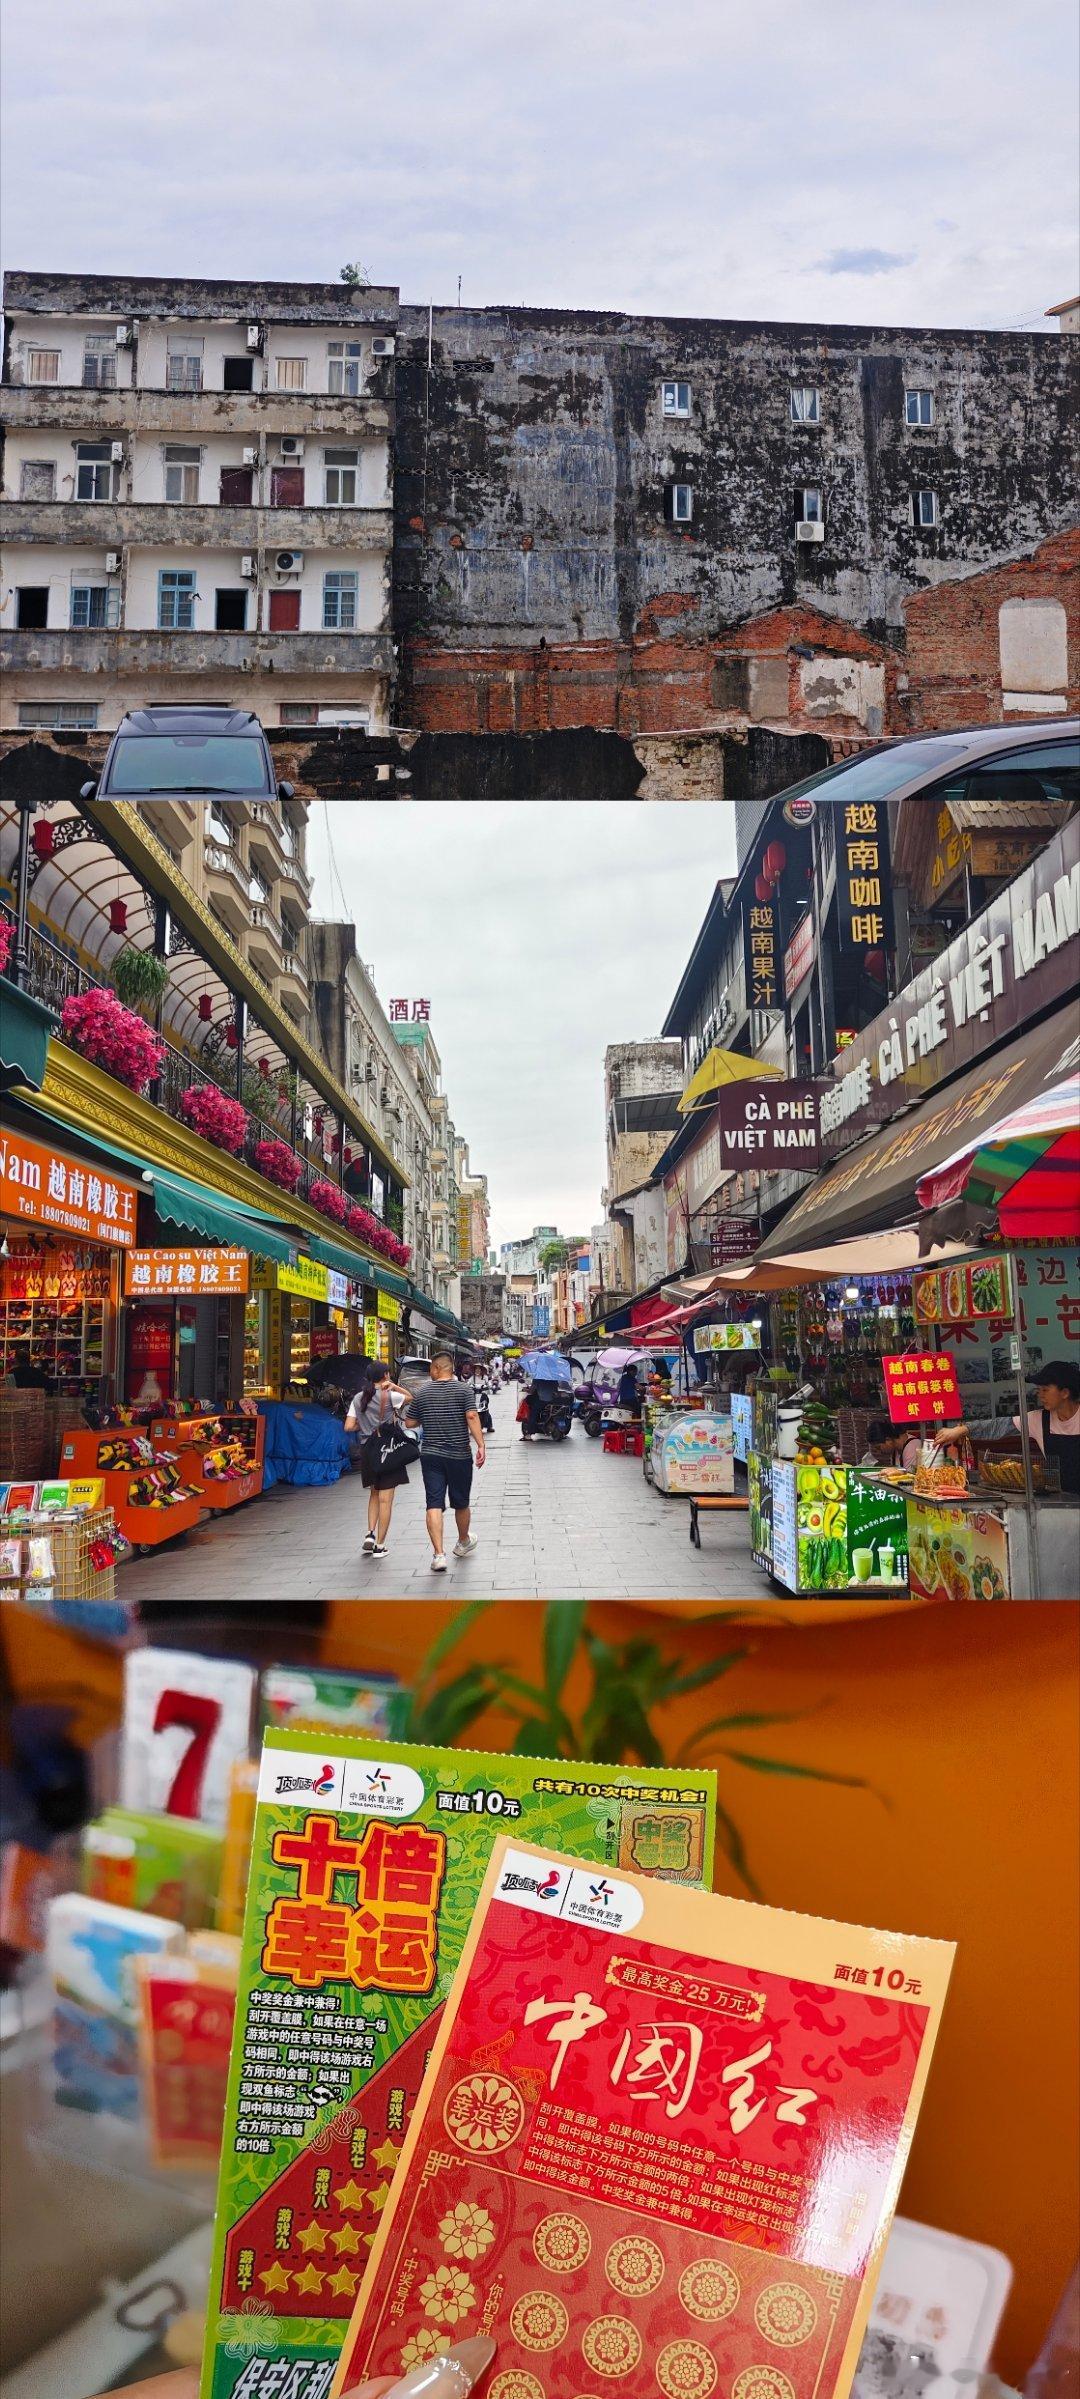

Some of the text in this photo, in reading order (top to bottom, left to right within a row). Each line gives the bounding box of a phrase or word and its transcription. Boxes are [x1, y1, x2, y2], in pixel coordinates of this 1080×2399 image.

[844, 803, 883, 945] 越南咖啡
[749, 906, 776, 1005] 越南果汁
[878, 1017, 904, 1087] CÀ
[905, 976, 948, 1067] PHÊ
[949, 934, 1006, 1028] VIỆT
[1011, 862, 1080, 980] NAM
[389, 998, 430, 1021] 酒店
[745, 1093, 815, 1121] CÀ PHÊ
[724, 1124, 816, 1154] VIỆT NAM
[47, 1158, 133, 1222] 越南橡胶王
[18, 1197, 37, 1215] Tel:
[41, 1204, 90, 1232] 18807809021
[128, 1249, 247, 1262] Vua Cao su Việt Nam
[131, 1264, 242, 1284] 越南橡胶王
[889, 1357, 950, 1375] 越南春卷
[153, 1689, 222, 1818] 7
[349, 1792, 405, 1805] 中国体育彩票
[438, 1790, 520, 1816] 面值10元
[535, 1779, 706, 1802] 共有10次中奖机会!
[274, 1817, 444, 1905] 十倍
[570, 1901, 623, 1923] 中国体育彩票
[265, 1902, 435, 1990] 幸运
[621, 1965, 684, 1996] 最高奖金
[687, 1983, 711, 2002] 25
[834, 1963, 922, 1995] 面值10元
[246, 2027, 374, 2049] 游戏中的任意号码与中奖号
[239, 2100, 316, 2119] 即中得该场游戏
[389, 2088, 405, 2130] 游戏六
[450, 2094, 518, 2133] 幸运奖
[237, 2119, 304, 2137] 右方所示金额
[351, 2127, 367, 2168] 游戏七
[313, 2167, 332, 2208] 游戏八
[276, 2208, 293, 2249] 游戏九
[237, 2250, 254, 2291] 游戏十
[390, 2258, 418, 2317] 中奖号码
